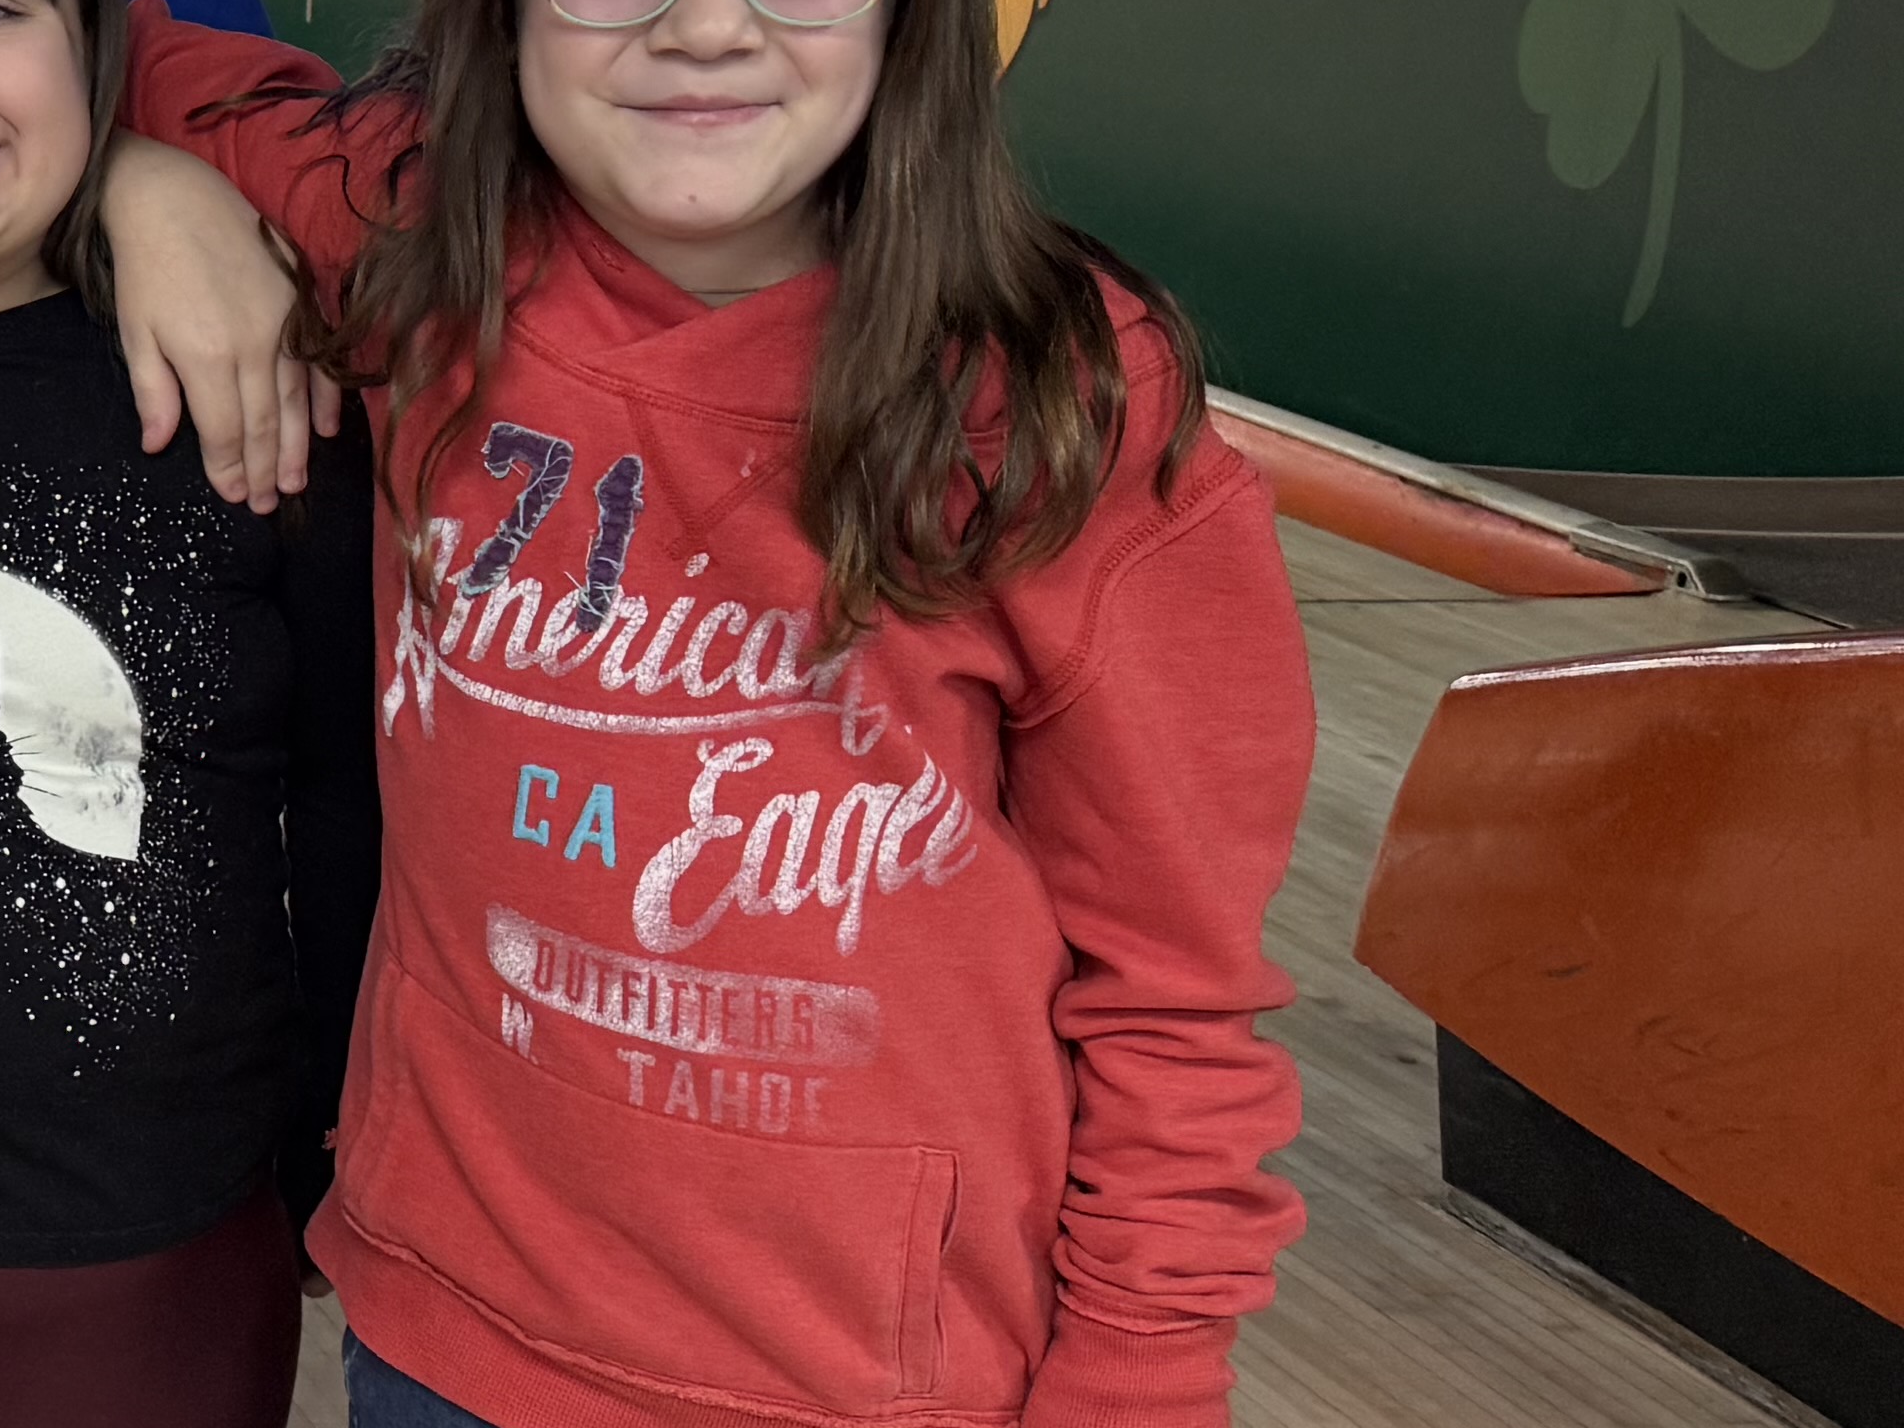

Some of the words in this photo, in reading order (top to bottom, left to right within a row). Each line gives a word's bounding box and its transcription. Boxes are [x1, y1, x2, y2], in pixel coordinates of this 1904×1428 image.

[464, 422, 644, 632] 71
[512, 763, 616, 868] CA
[632, 736, 978, 956] Eagle
[532, 938, 814, 1052] OUTFITTERS
[616, 1047, 832, 1138] TAHOE
